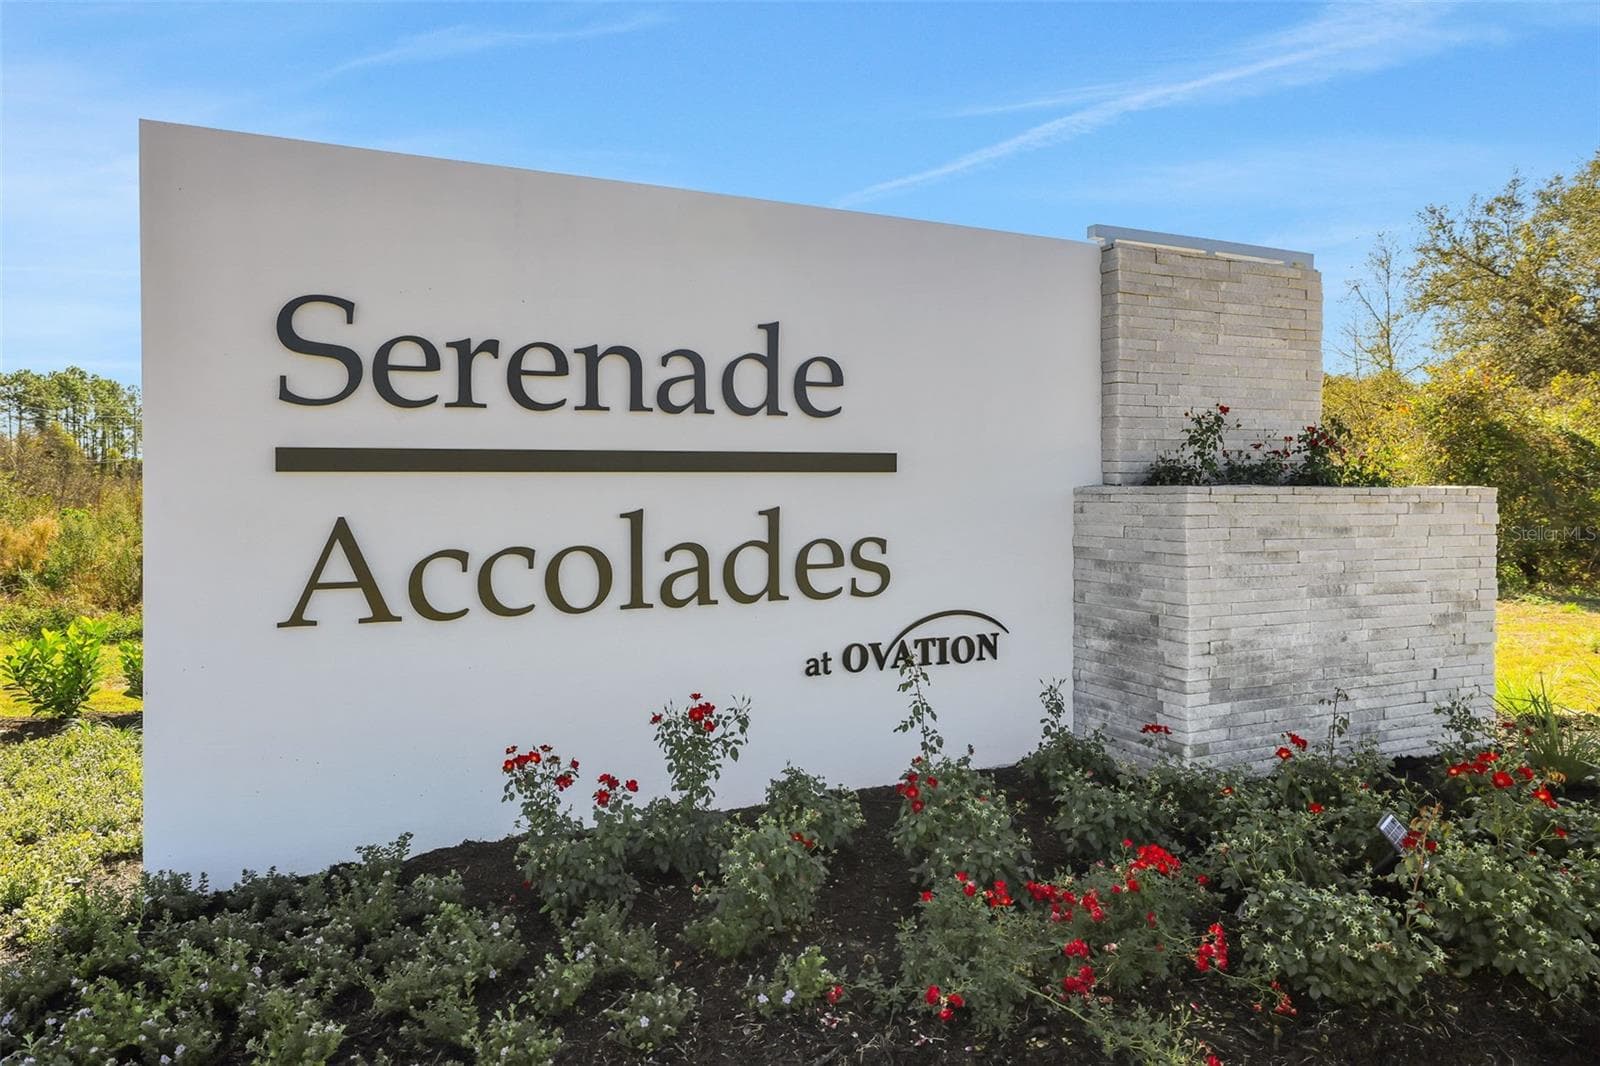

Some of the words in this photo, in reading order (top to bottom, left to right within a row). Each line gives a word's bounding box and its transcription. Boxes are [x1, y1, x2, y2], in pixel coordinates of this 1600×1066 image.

[276, 294, 845, 419] Serenade
[276, 506, 891, 629] Accolades
[804, 651, 833, 678] at
[841, 632, 1000, 674] OVATION
